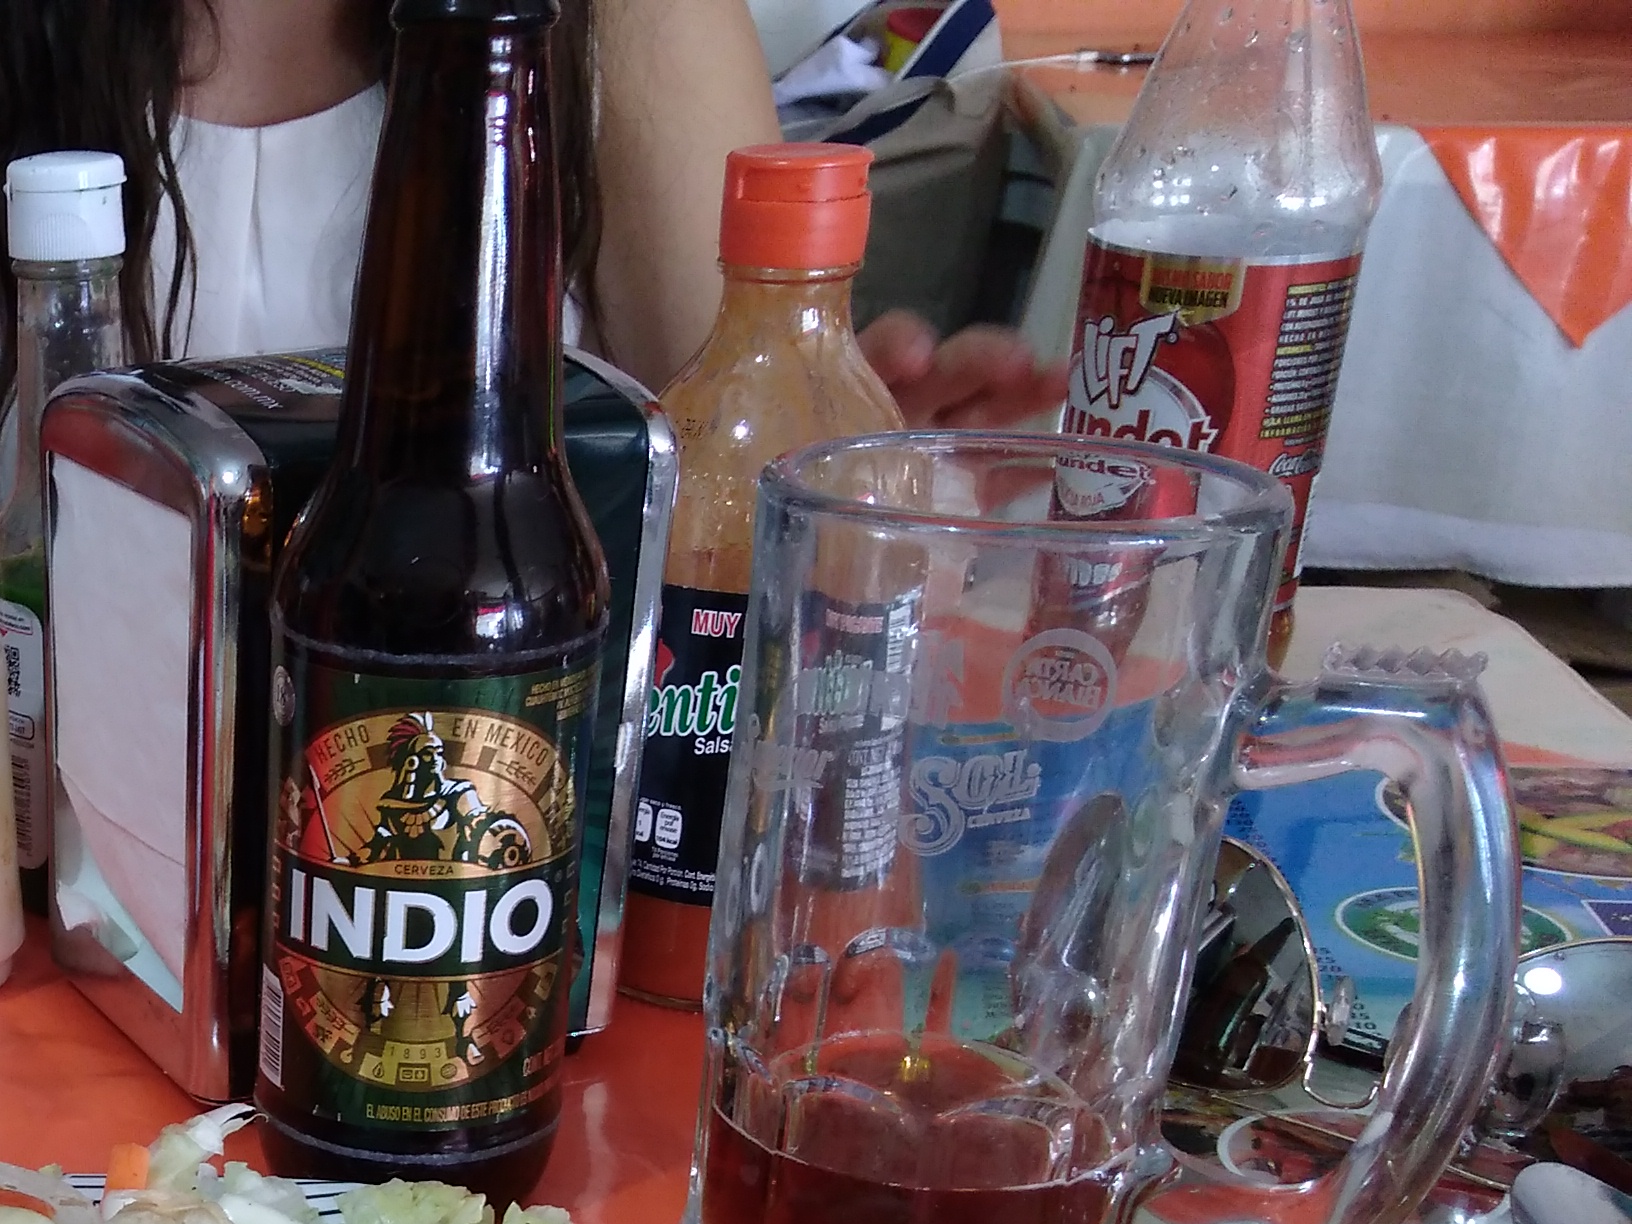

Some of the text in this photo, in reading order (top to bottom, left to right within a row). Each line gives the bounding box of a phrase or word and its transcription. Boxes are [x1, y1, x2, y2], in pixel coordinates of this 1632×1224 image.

[691, 608, 742, 639] MUY
[647, 664, 742, 737] enti
[316, 718, 549, 766] HECHO EN MEXICO
[694, 737, 734, 755] Sals
[394, 864, 454, 876] CERVEZA
[289, 868, 554, 964] INDIO
[389, 1045, 442, 1060] 1893
[366, 1104, 375, 1119] EL
[376, 1105, 401, 1121] ABUSO
[401, 1107, 413, 1121] EN
[414, 1107, 423, 1122] EL
[424, 1106, 460, 1123] CONSUMO
